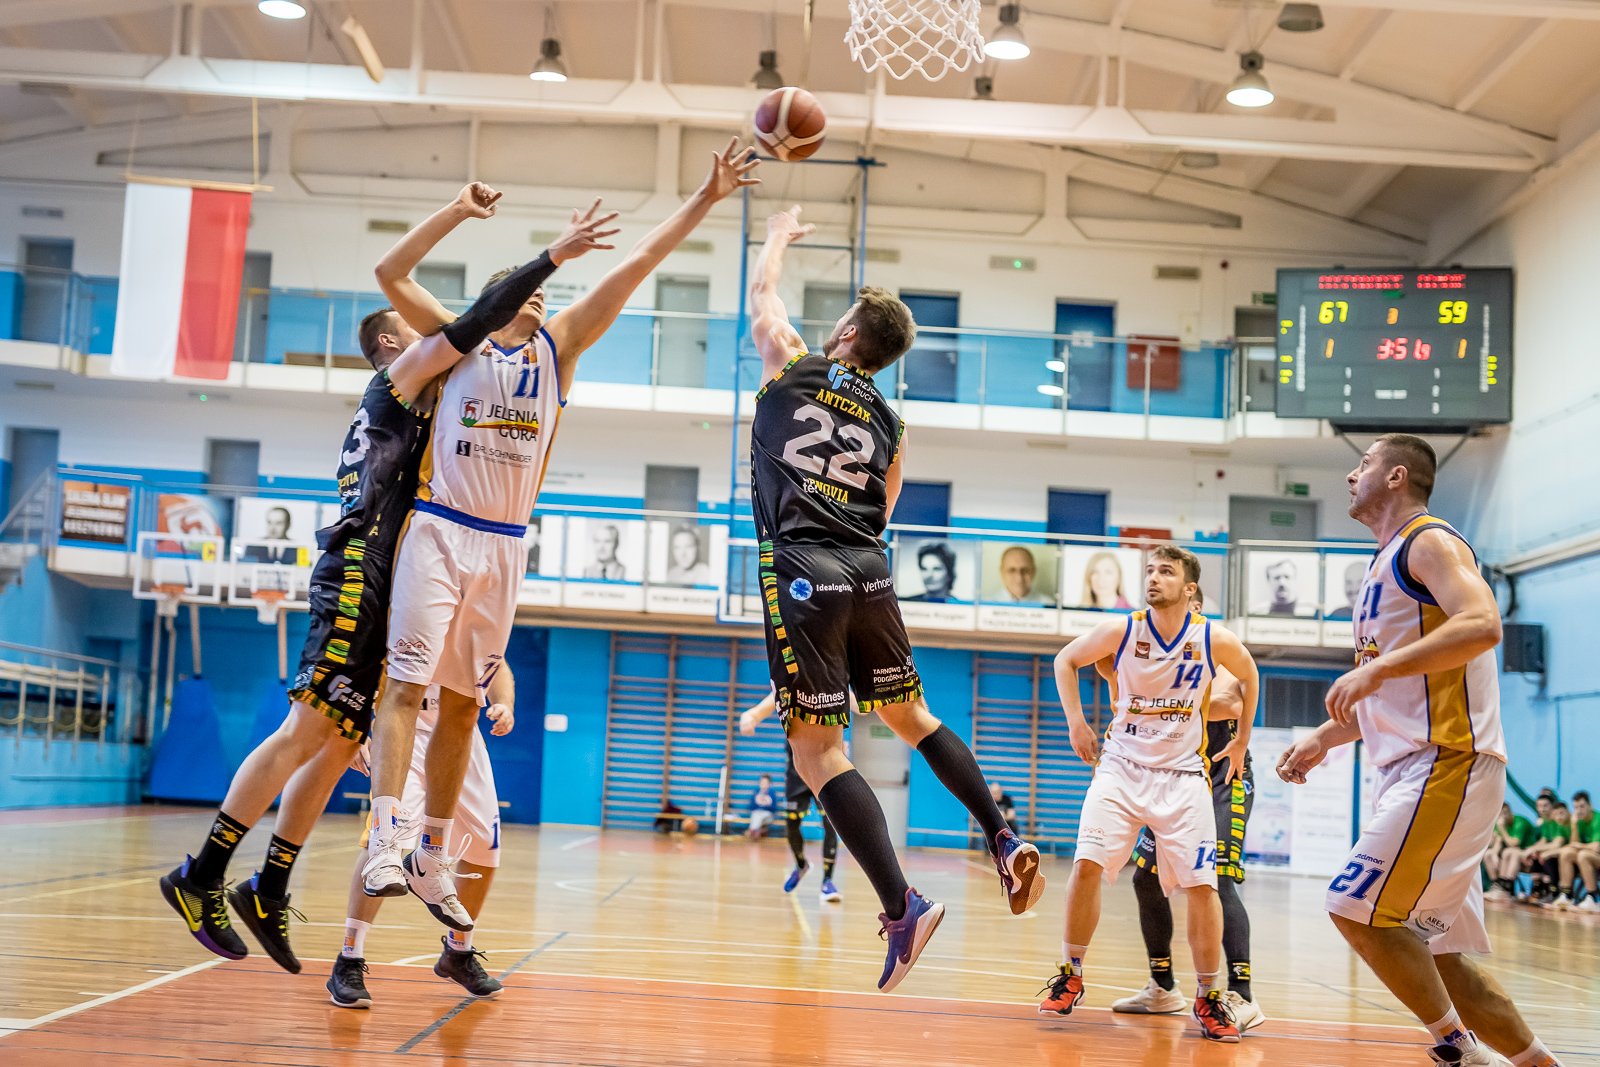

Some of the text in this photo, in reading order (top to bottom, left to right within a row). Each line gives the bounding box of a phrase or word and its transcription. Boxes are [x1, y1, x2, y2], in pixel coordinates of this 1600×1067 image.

[1318, 301, 1349, 324] 67
[1438, 301, 1469, 324] 59
[512, 366, 541, 400] 11
[841, 380, 875, 403] IN TOUCH
[854, 378, 878, 396] FIZJO
[486, 403, 539, 425] JELENIA
[815, 388, 872, 424] ANTCZAK
[499, 424, 537, 442] GÓRA
[782, 403, 876, 491] 22
[1169, 663, 1204, 690] 14
[796, 689, 845, 705] klubfitness
[1149, 697, 1194, 709] JELENIA
[1193, 846, 1217, 870] 14
[1328, 861, 1385, 901] 21
[1426, 915, 1446, 930] AREA
